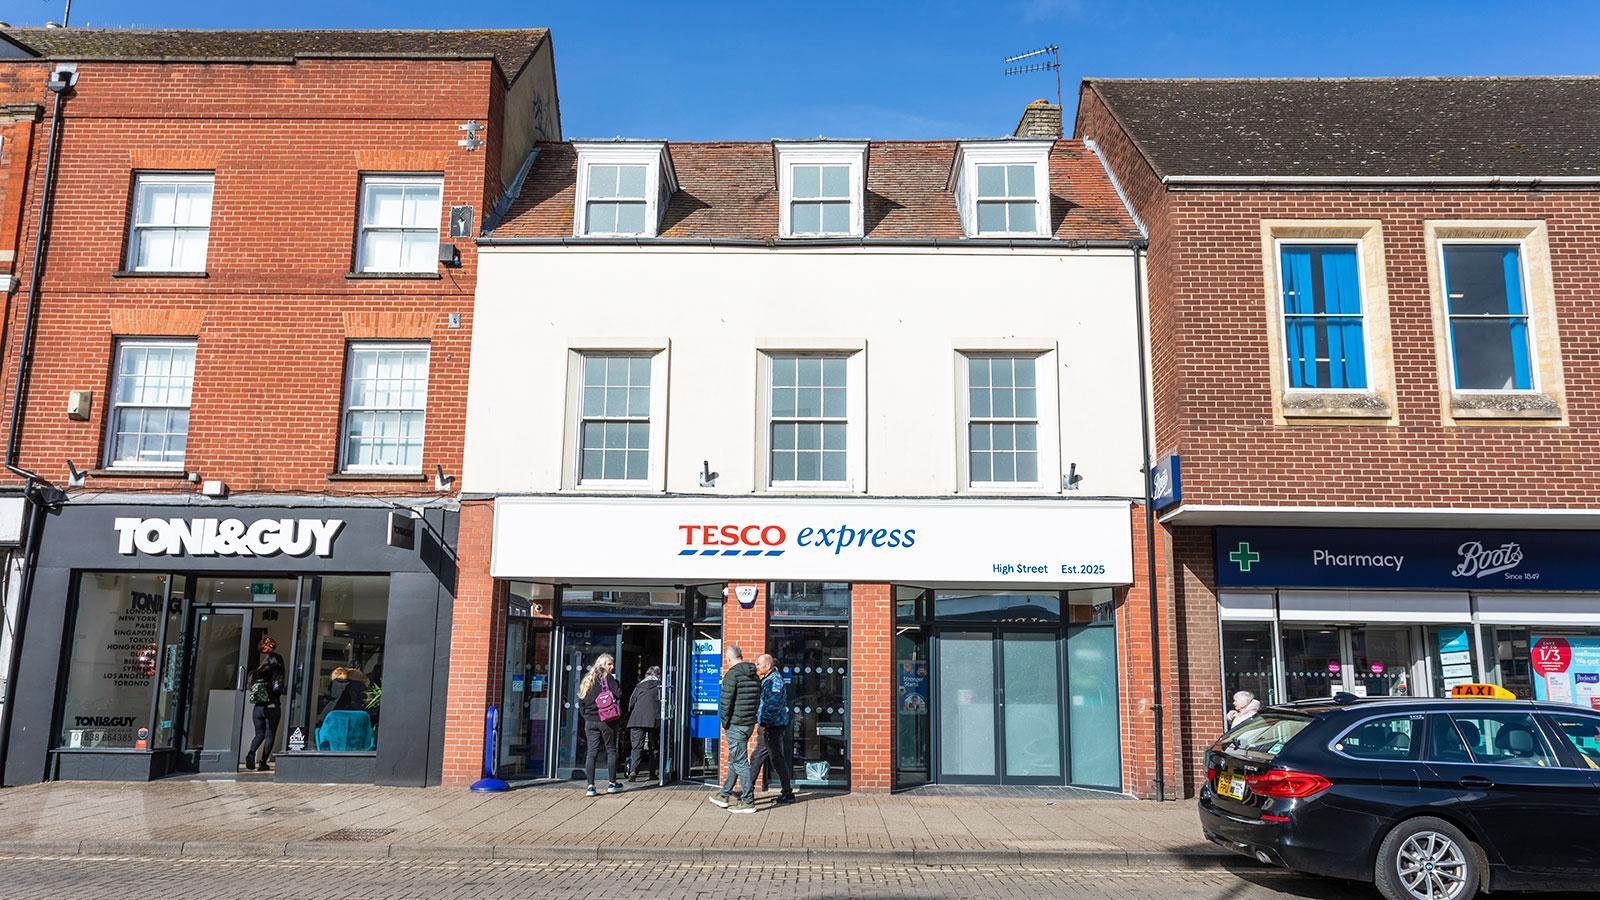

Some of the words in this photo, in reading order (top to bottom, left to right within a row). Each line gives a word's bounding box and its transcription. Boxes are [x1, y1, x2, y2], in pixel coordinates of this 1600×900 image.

[114, 517, 345, 557] TONI&GUY
[678, 525, 786, 546] TESCO
[797, 524, 916, 554] express
[1313, 550, 1404, 571] Pharmacy
[1452, 541, 1523, 578] Boots
[992, 564, 1014, 575] High
[1017, 564, 1048, 574] Street
[1061, 565, 1105, 574] Est.2025
[1505, 572, 1522, 580] Since
[1539, 649, 1561, 661] 1/3
[1455, 685, 1491, 696] TAXI
[75, 716, 136, 727] TONI&GUY
